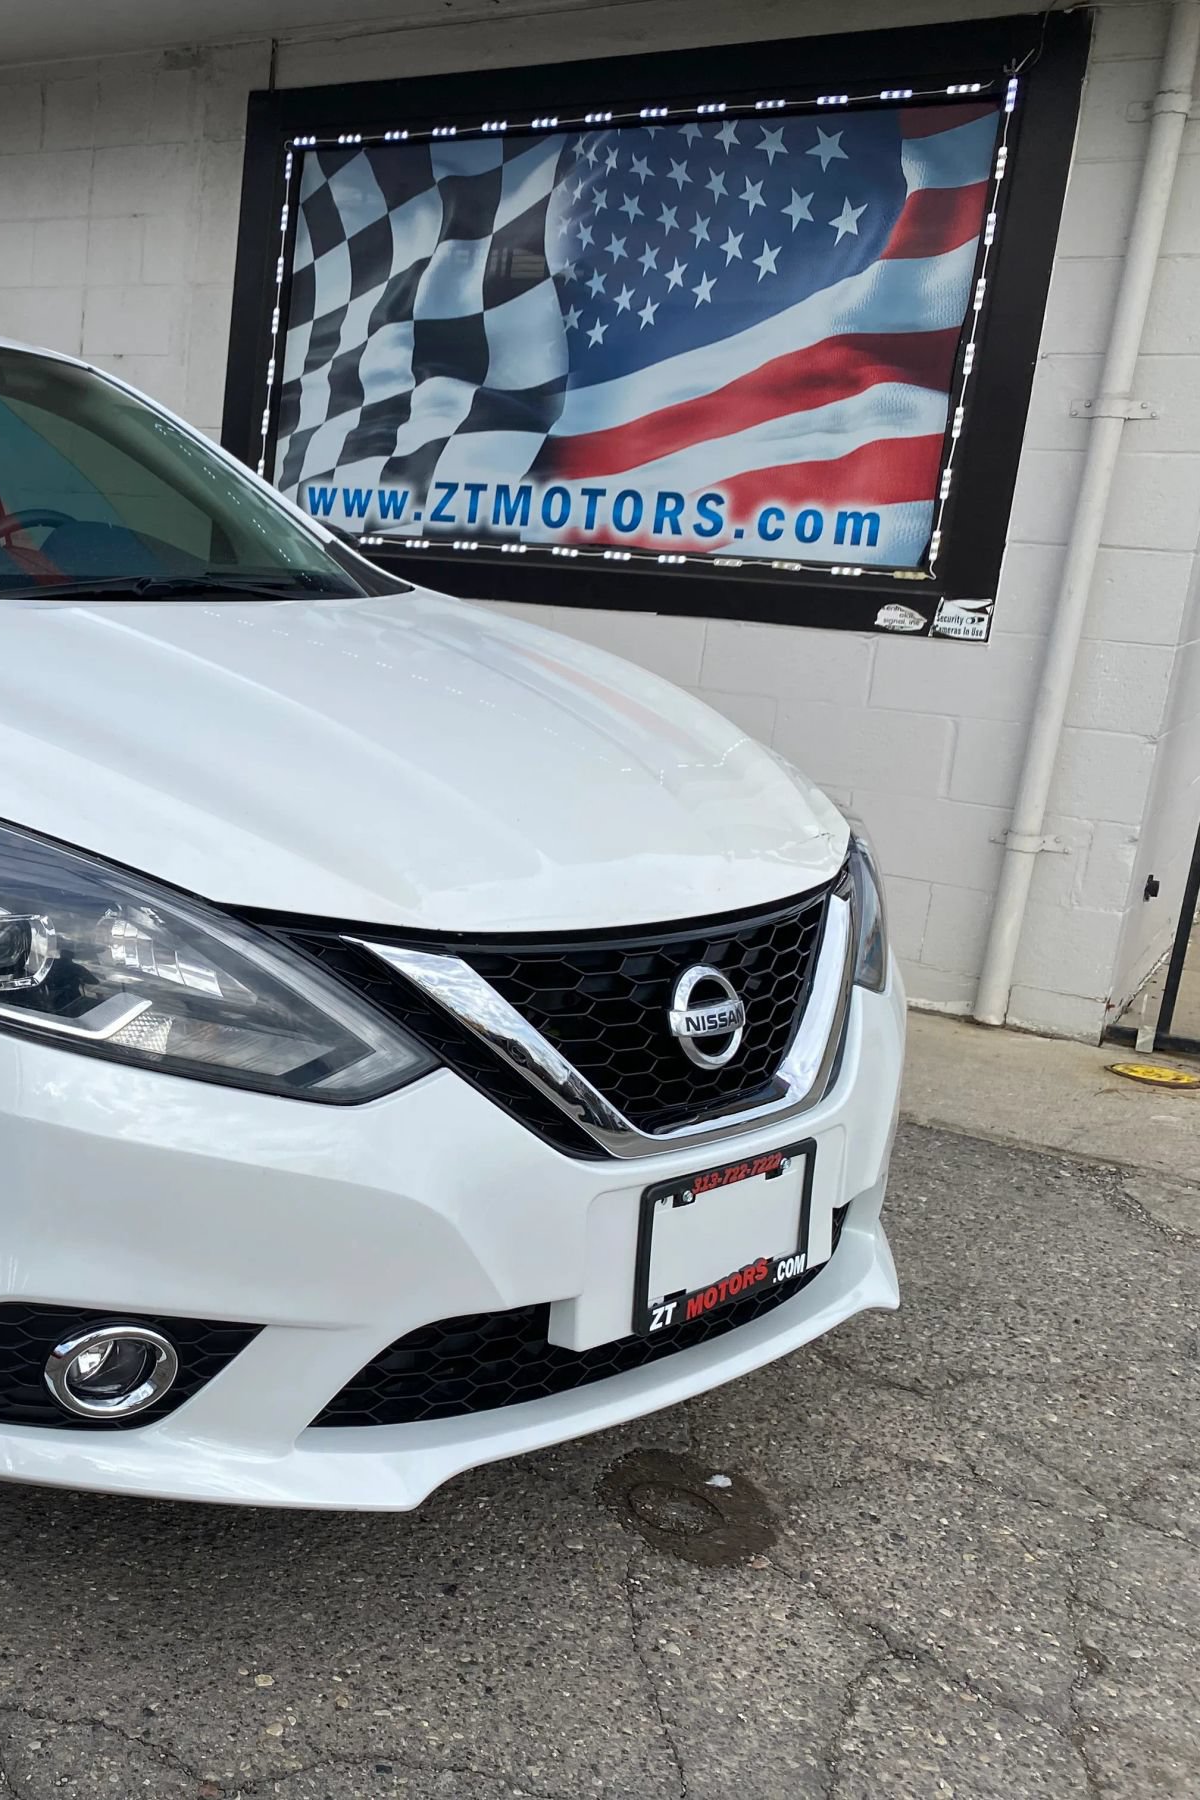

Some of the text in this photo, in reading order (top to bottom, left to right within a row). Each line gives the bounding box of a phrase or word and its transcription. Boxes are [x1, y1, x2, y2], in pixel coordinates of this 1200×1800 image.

[307, 481, 882, 548] www.ZTMOTORS.com
[936, 613, 964, 625] Security
[962, 626, 970, 636] In
[971, 627, 983, 637] Use
[685, 1009, 744, 1032] NISSAN
[692, 1151, 783, 1194] 313-722-7222
[649, 1253, 806, 1331] ZT MOTORS .COM
